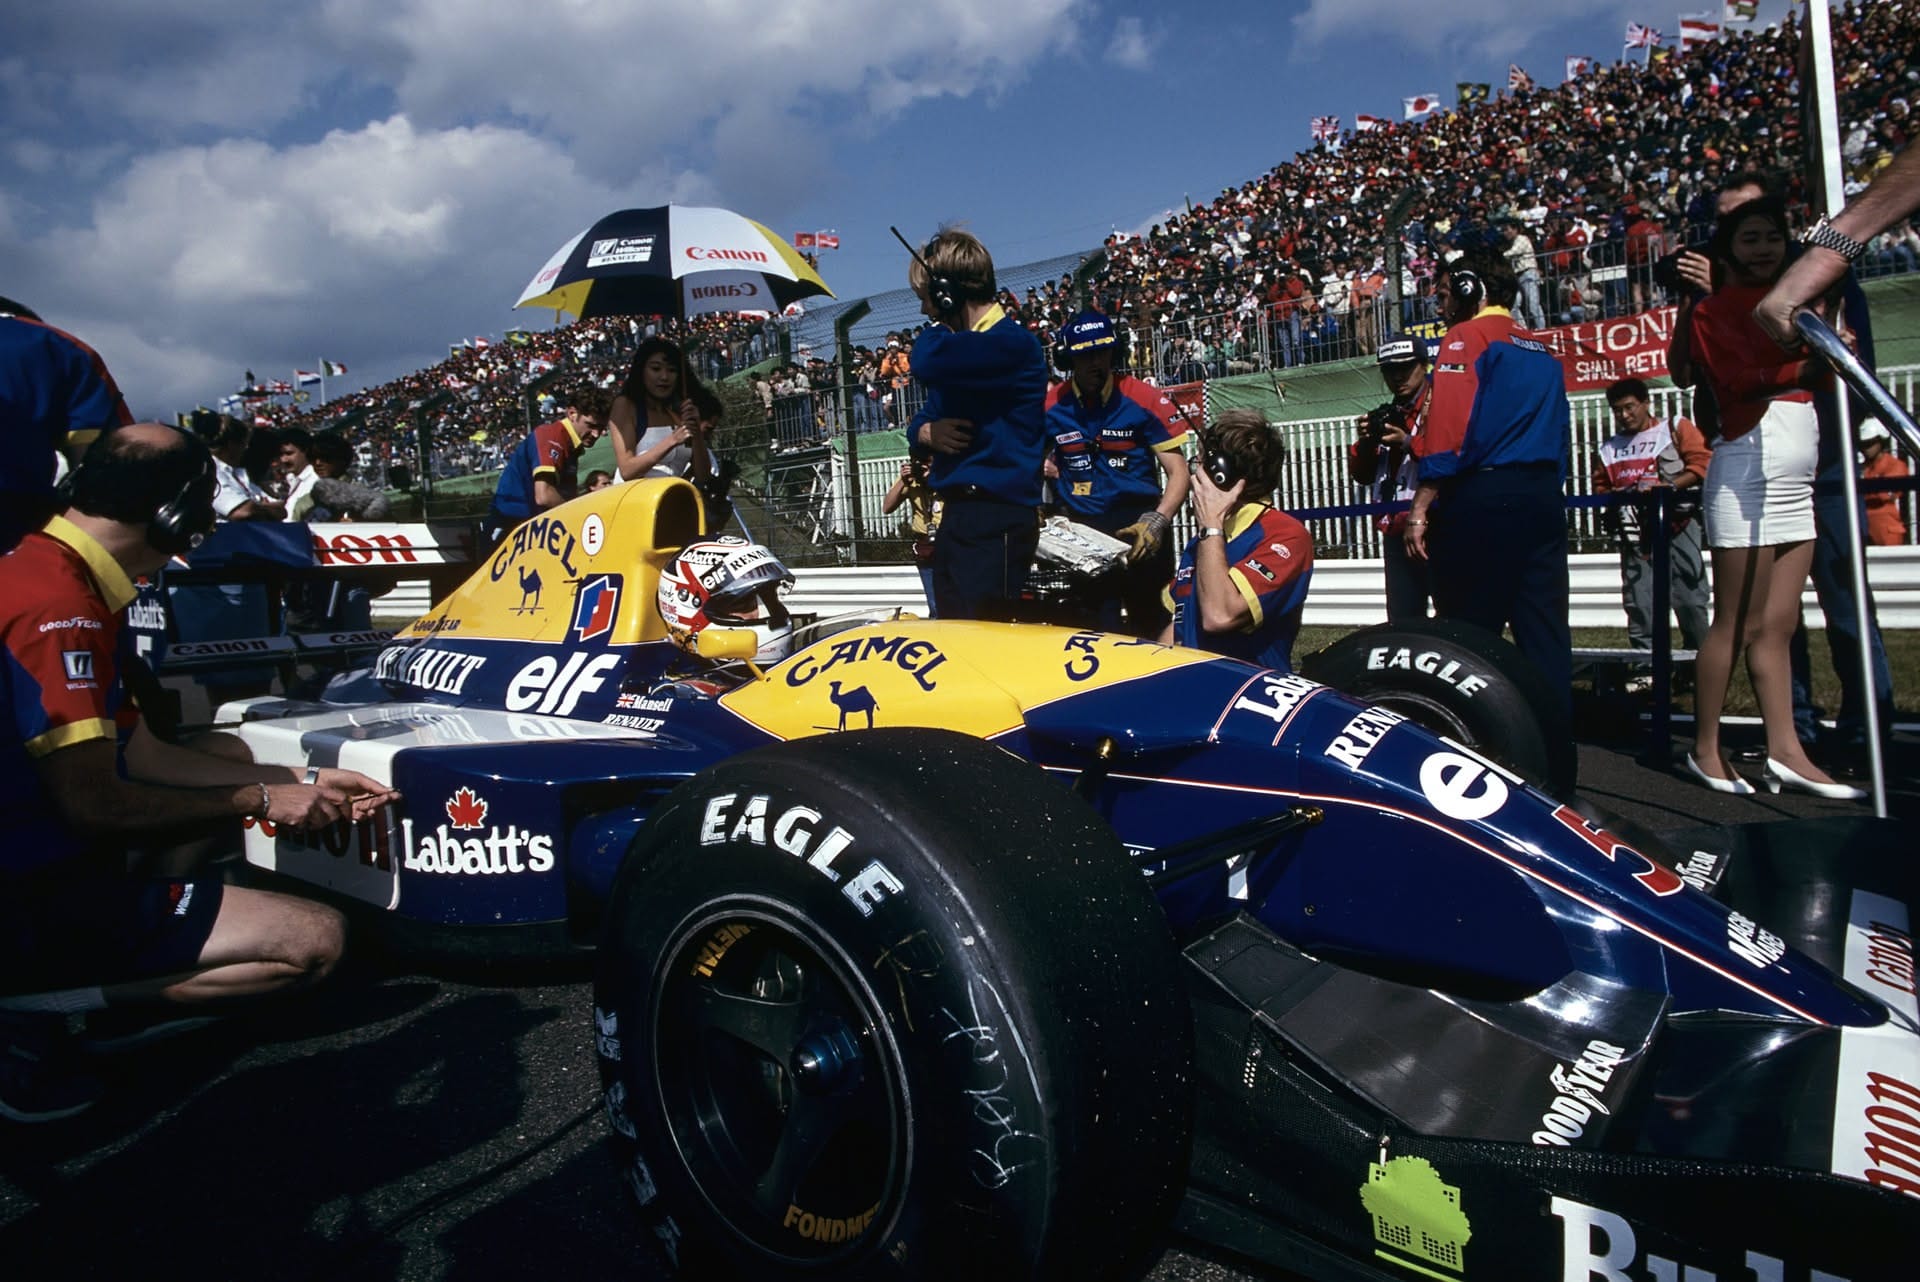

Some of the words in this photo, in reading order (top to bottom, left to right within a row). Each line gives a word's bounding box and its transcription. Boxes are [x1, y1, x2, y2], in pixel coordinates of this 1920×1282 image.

[686, 246, 768, 263] Canon
[1073, 322, 1104, 334] Canon
[1576, 360, 1620, 383] SHALL
[1102, 428, 1133, 438] RENAULT
[1614, 441, 1656, 458] 15177
[1108, 457, 1128, 468] elf
[588, 526, 597, 544] E
[491, 518, 577, 582] CAMEL
[703, 566, 728, 590] elf
[39, 616, 102, 632] GOODYEAR
[173, 639, 269, 656] Canon
[375, 646, 487, 695] RENAULT
[786, 636, 948, 692] CAMEL
[1367, 646, 1488, 698] EAGLE
[505, 651, 622, 716] elf
[631, 694, 674, 712] Mansell
[601, 713, 665, 732] RENAULT
[402, 818, 555, 874] Labatt's
[700, 793, 904, 917] EAGLE
[1551, 803, 1685, 897] 5
[1865, 920, 1917, 997] Canon
